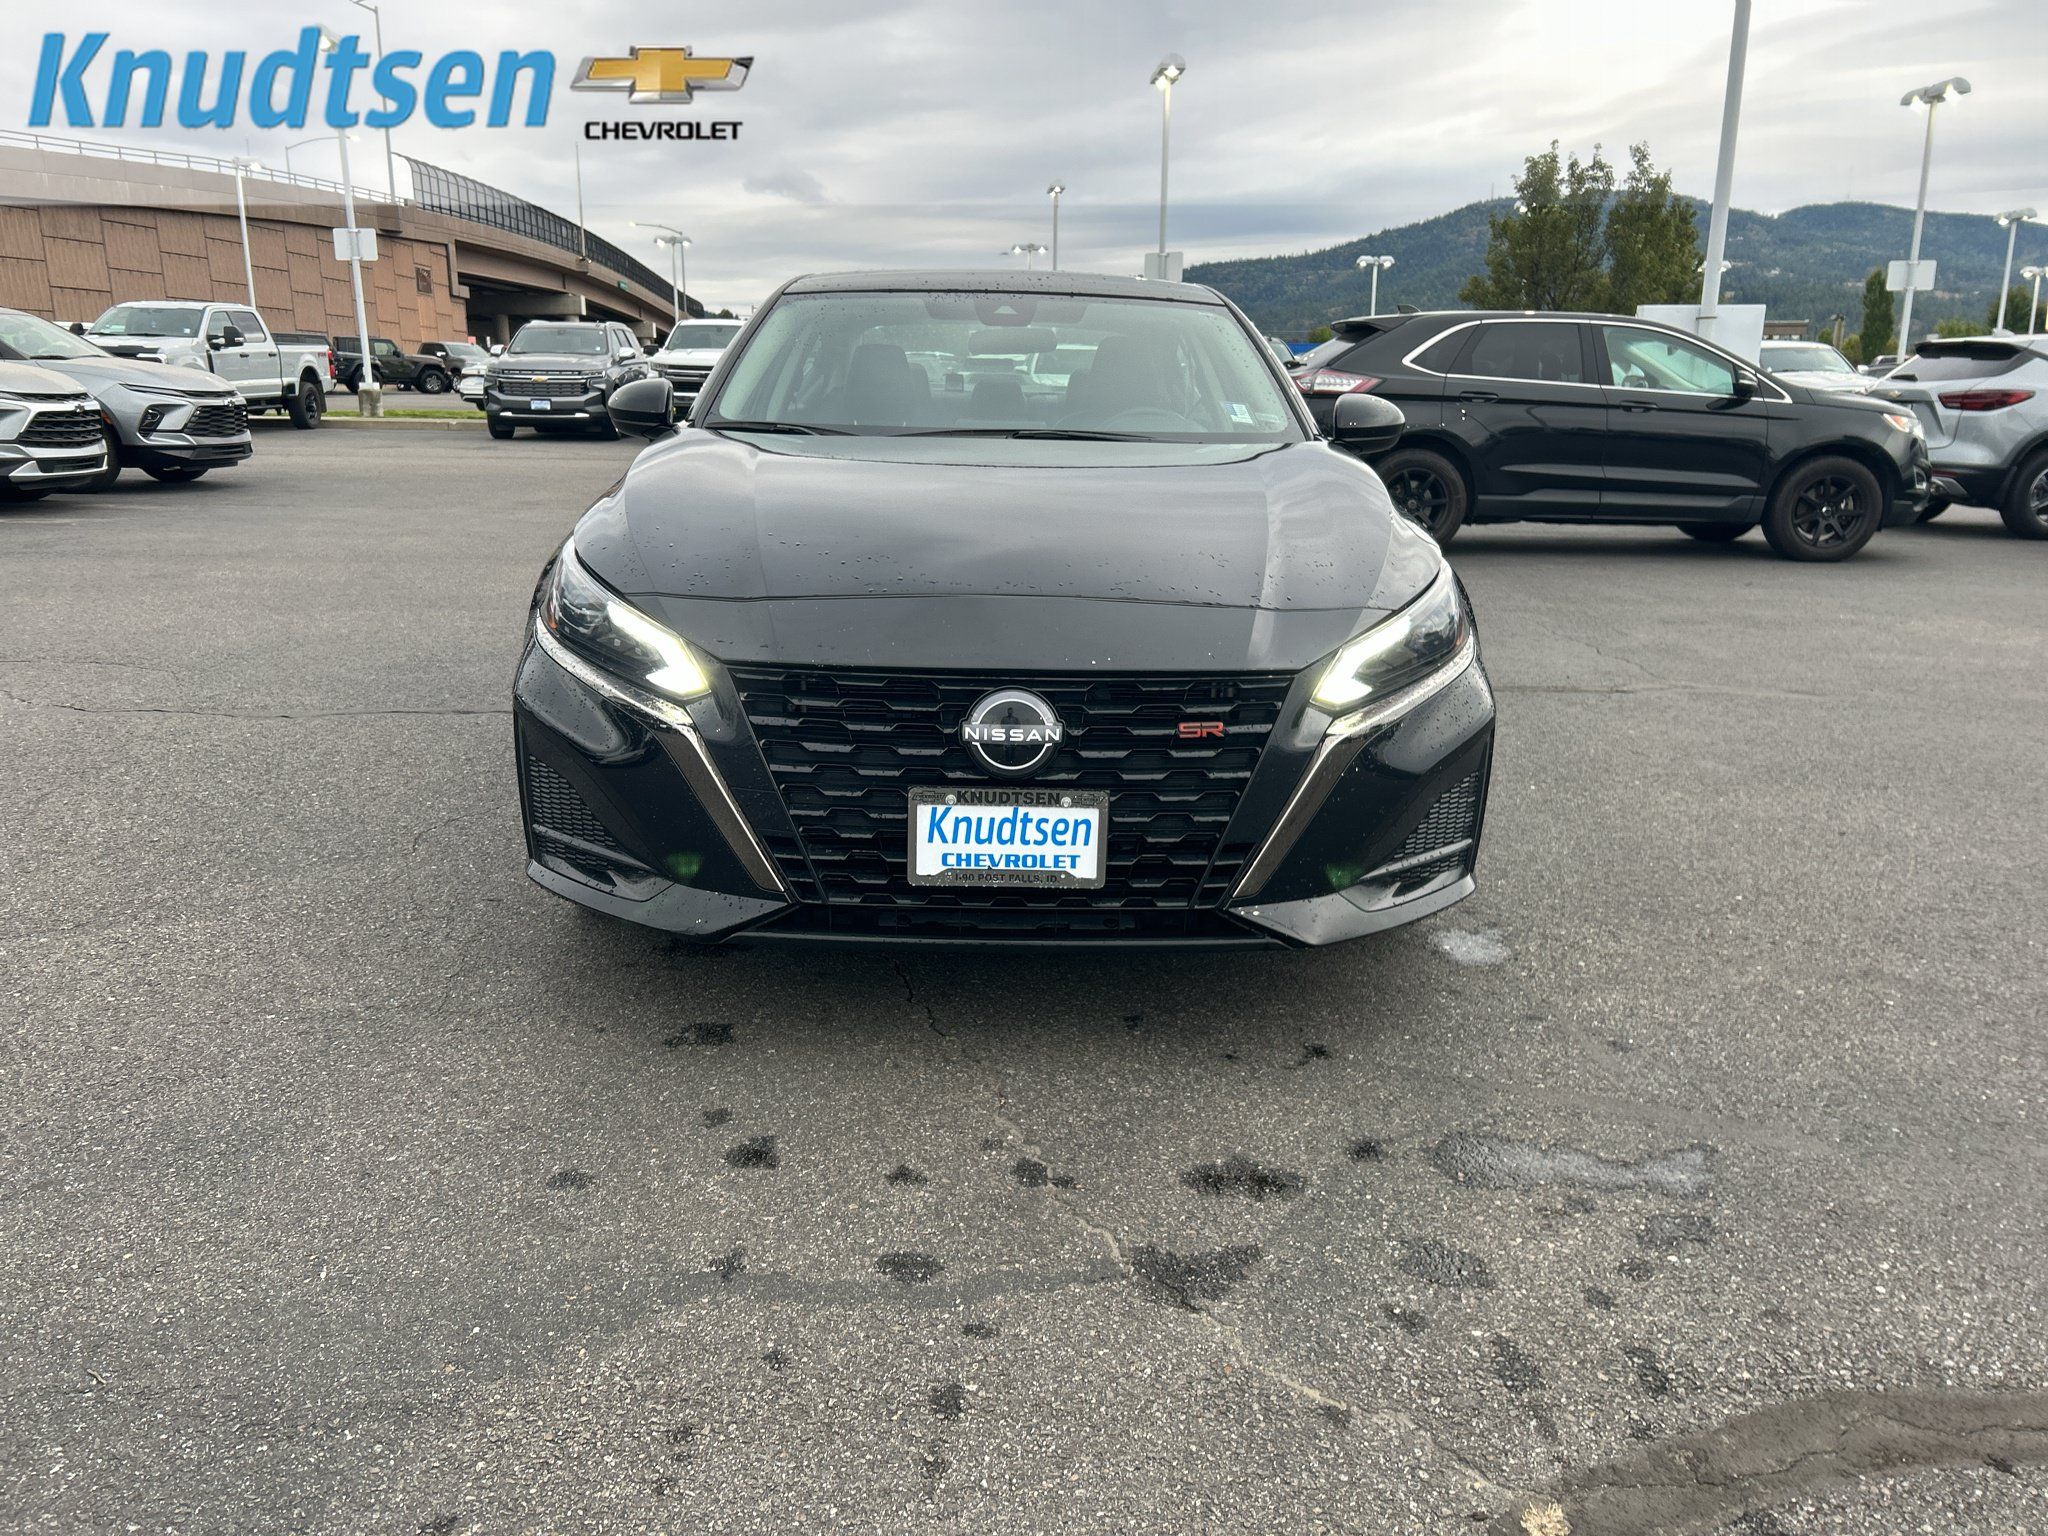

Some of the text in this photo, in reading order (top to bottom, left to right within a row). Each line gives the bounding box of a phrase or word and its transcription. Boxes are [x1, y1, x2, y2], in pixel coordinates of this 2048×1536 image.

[964, 727, 1060, 742] NISSAN
[1178, 721, 1225, 739] SR
[956, 790, 1061, 805] KNUDTSEN
[928, 806, 1091, 846] Knudtsen
[942, 853, 1080, 869] CHEVROLET
[977, 874, 1005, 883] POST
